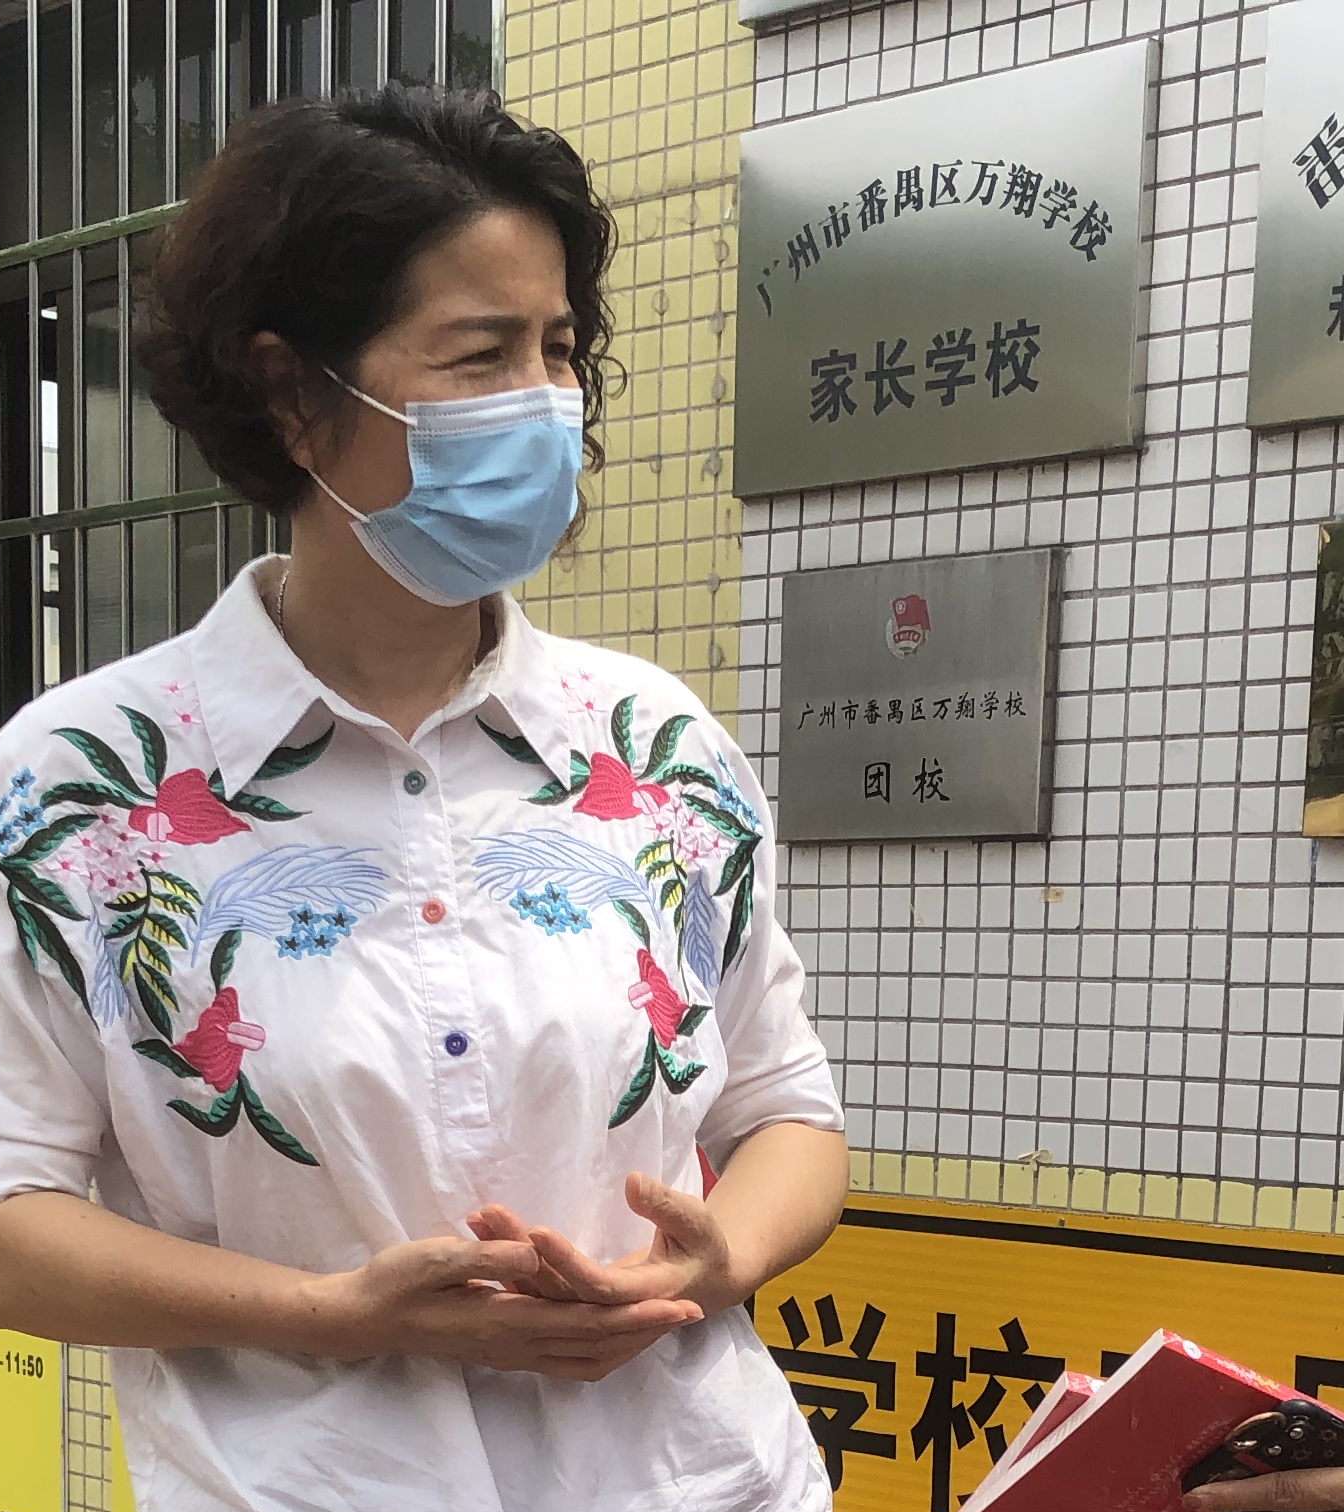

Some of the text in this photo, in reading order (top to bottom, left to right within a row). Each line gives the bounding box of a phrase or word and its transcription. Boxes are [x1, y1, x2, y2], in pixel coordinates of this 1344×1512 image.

[756, 160, 1113, 316] 广州市番禺区万翔学校
[809, 318, 1041, 424] 家长学校
[797, 691, 1027, 731] 广州市番禺区万翔学校
[863, 758, 951, 803] 团校
